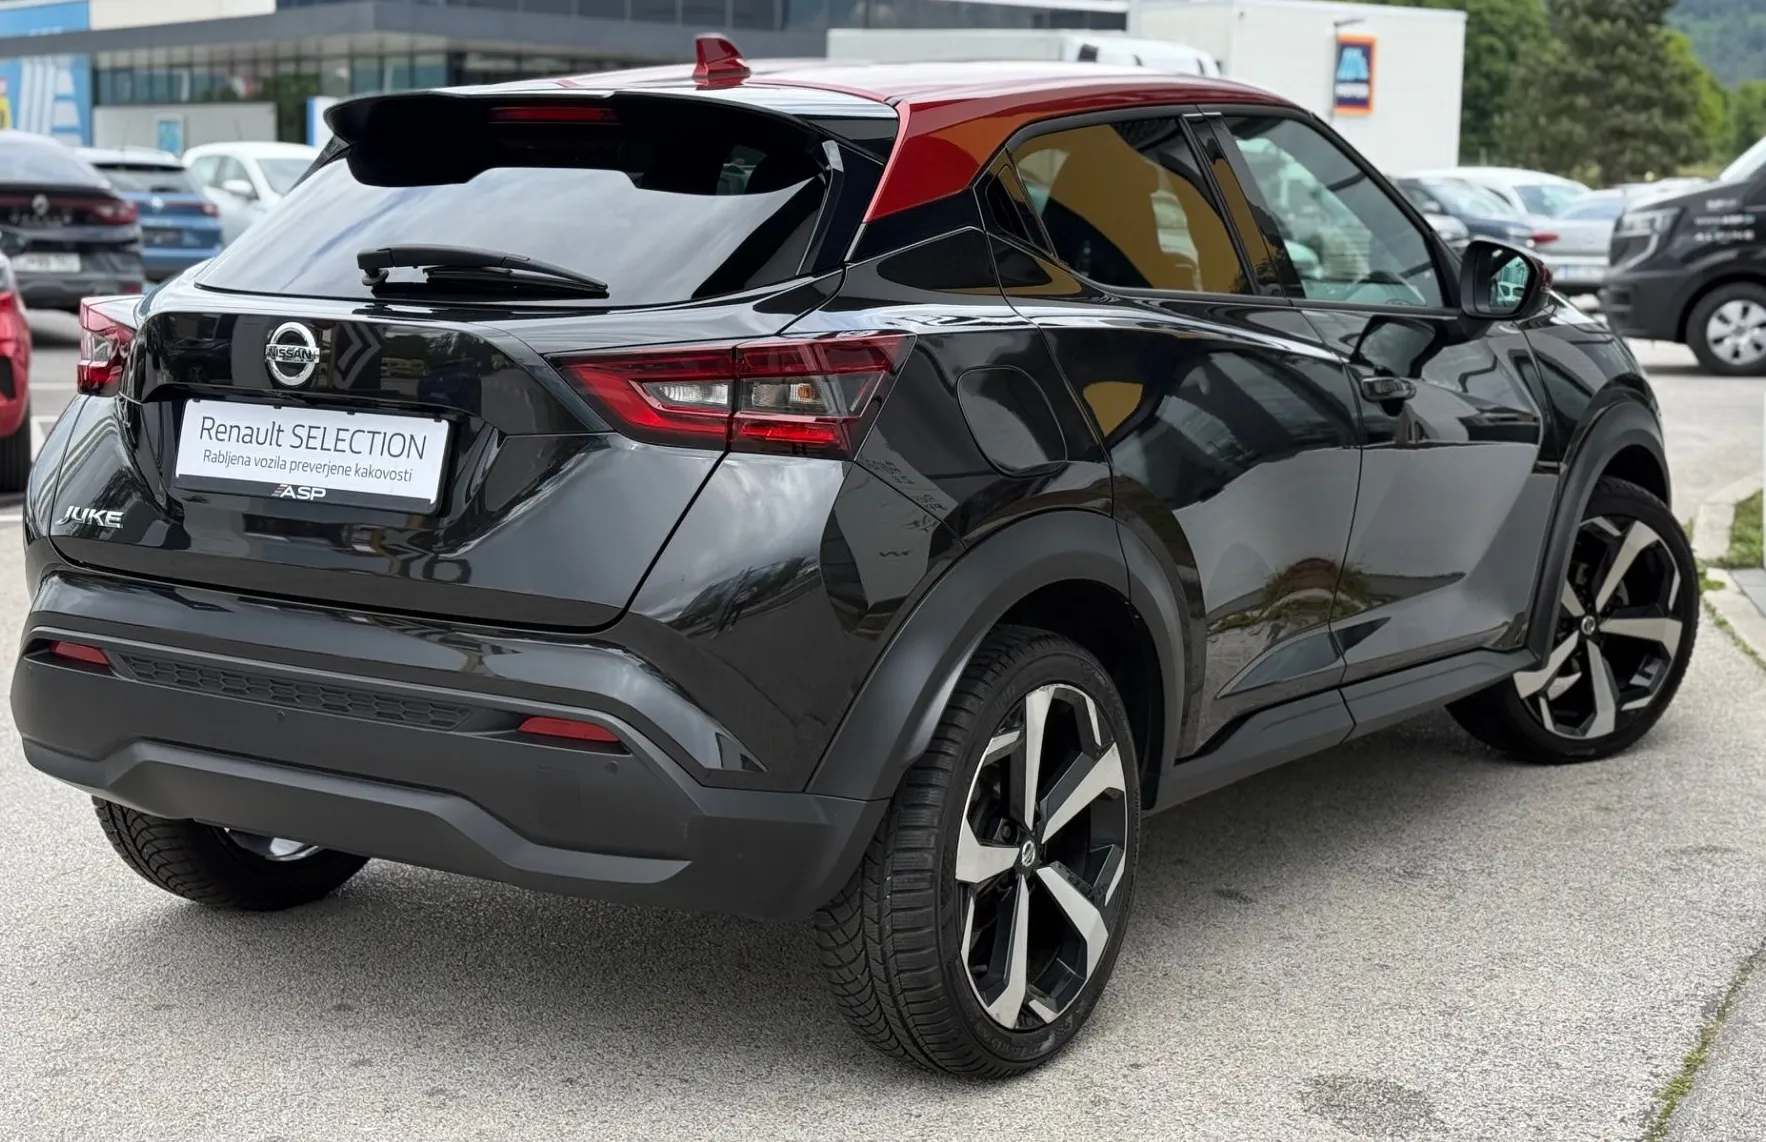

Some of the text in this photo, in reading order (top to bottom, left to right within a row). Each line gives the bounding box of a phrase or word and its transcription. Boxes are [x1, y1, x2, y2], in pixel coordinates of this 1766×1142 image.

[267, 346, 312, 360] NISSAN
[199, 416, 427, 460] Renault SELECTION
[203, 449, 413, 483] Rabljena vozila preverjene kakovosti
[279, 485, 327, 501] ASP
[54, 505, 124, 529] JUKE
